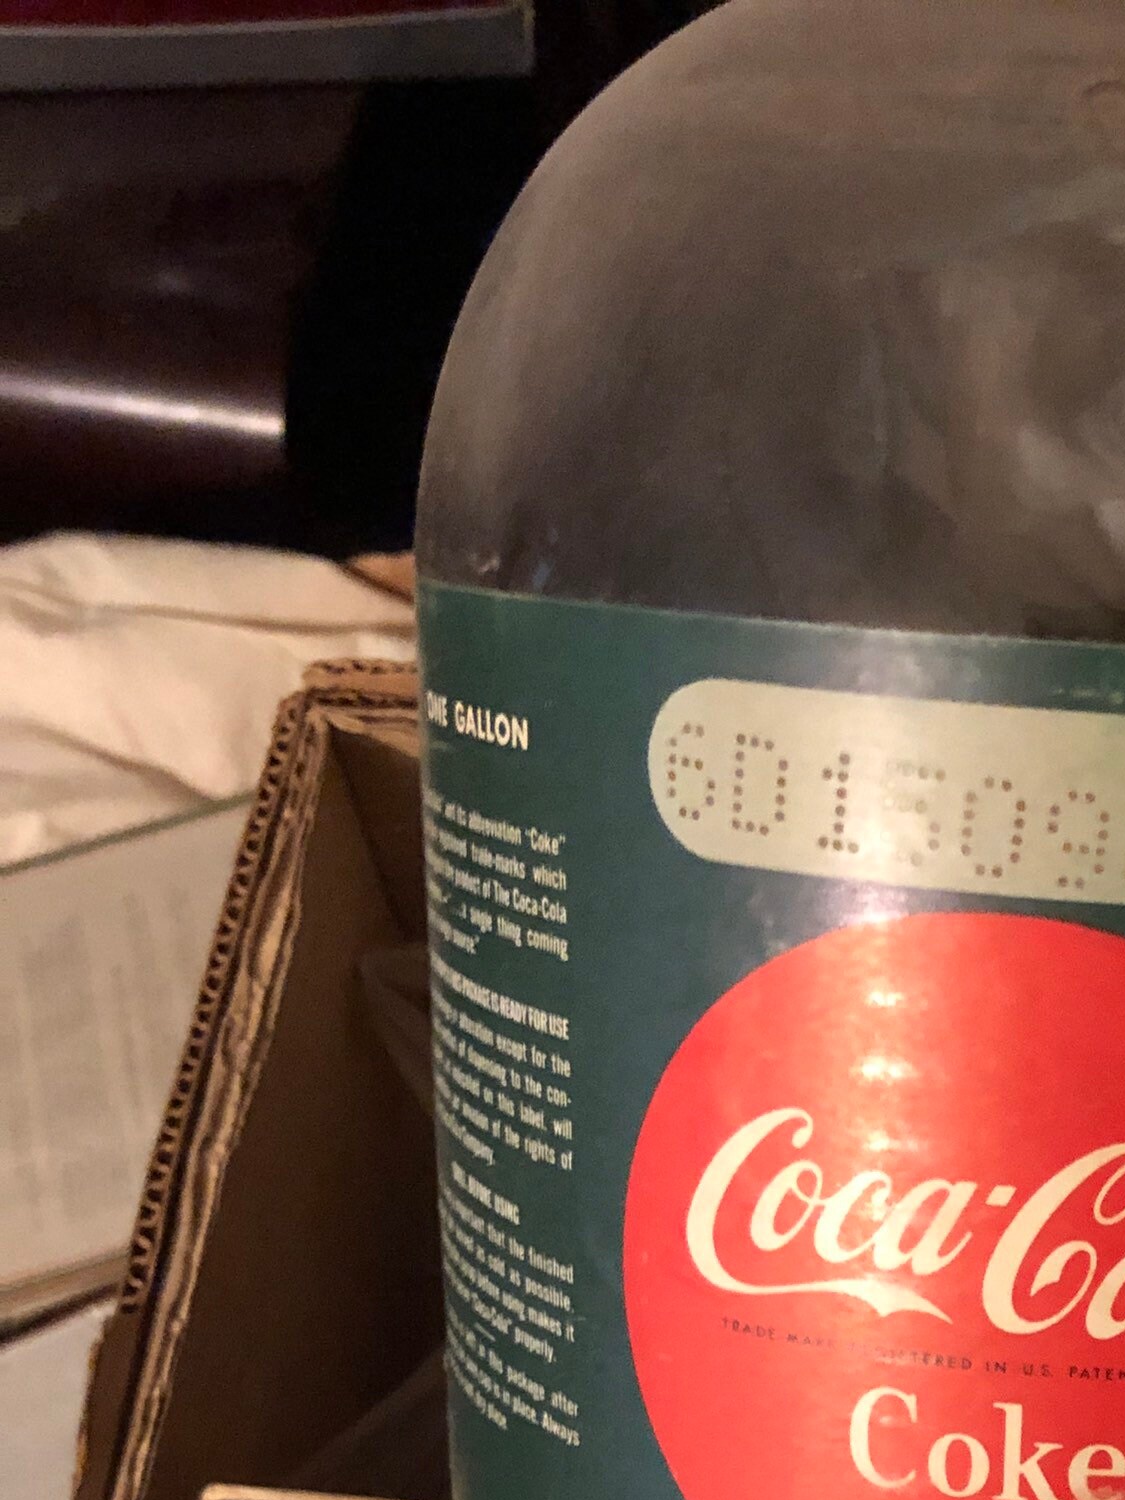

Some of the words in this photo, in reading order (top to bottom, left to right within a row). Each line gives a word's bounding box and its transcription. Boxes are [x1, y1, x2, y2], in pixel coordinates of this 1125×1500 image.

[426, 690, 449, 727] ONE
[455, 701, 529, 751] GALLON
[533, 864, 567, 891] which
[527, 929, 568, 961] coming
[549, 1012, 570, 1041] USE
[560, 1150, 573, 1170] of
[528, 1245, 574, 1285] finished
[722, 1316, 777, 1341] TRADE
[985, 1360, 1007, 1375] IN
[551, 1390, 579, 1417] after
[541, 1410, 581, 1448] Always
